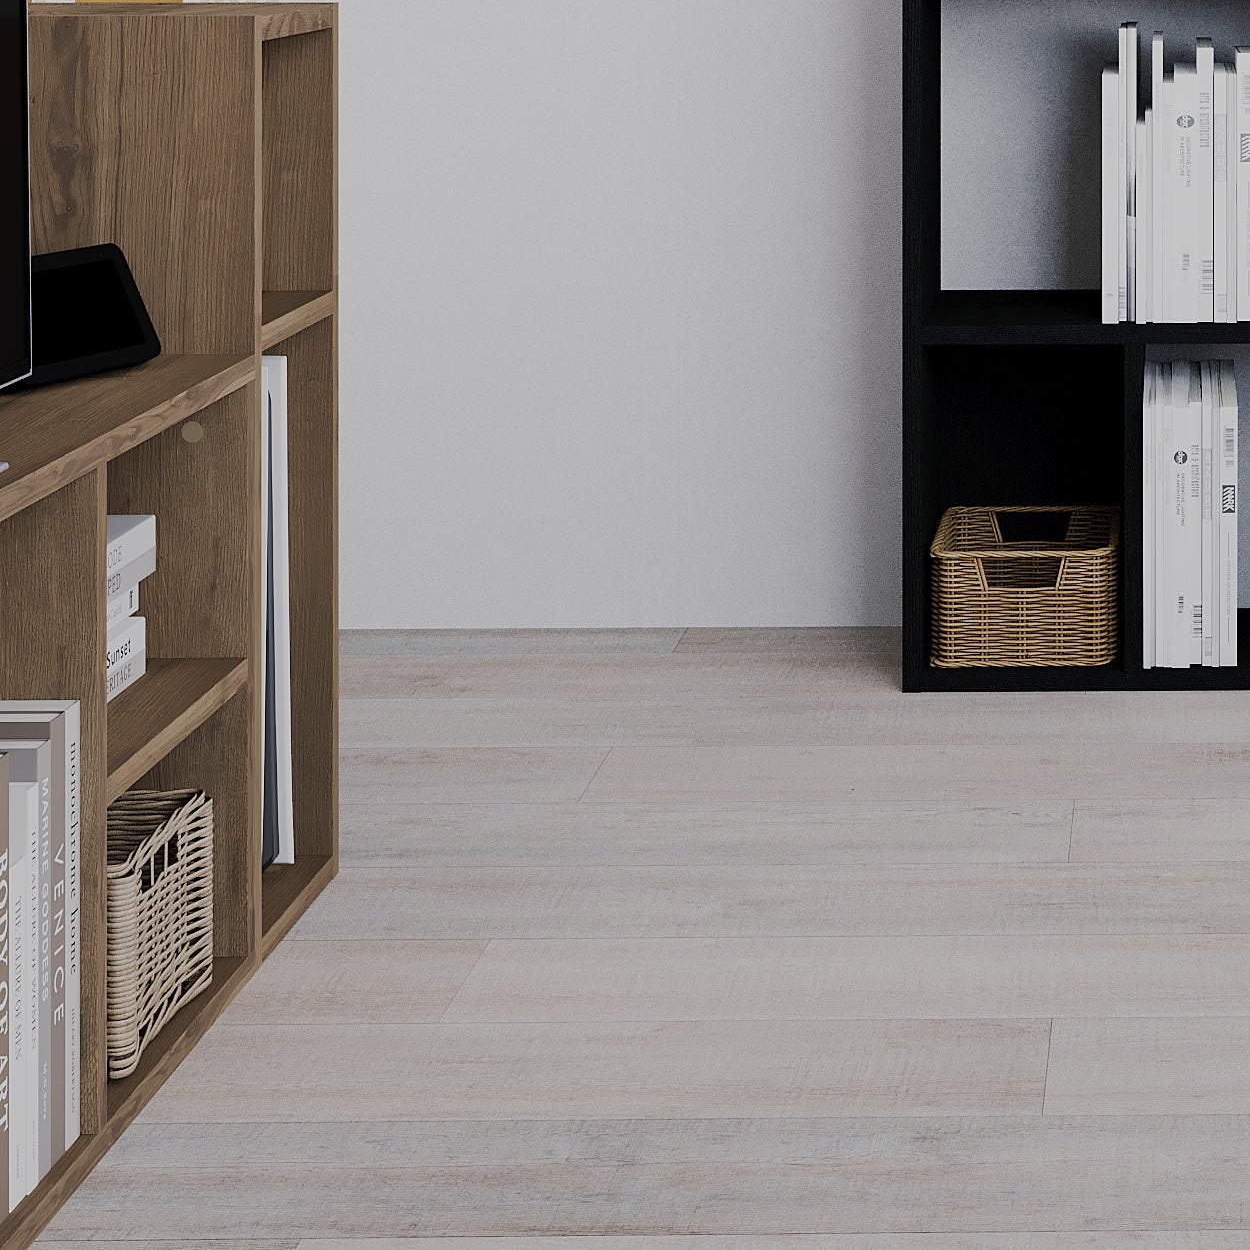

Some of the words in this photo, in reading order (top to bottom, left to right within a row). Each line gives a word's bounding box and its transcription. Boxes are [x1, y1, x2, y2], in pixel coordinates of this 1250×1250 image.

[1223, 486, 1235, 512] MARK
[107, 545, 123, 569] ODE
[106, 638, 131, 669] Sunset
[106, 663, 132, 694] ERITAGE
[41, 777, 49, 875] MARINE
[70, 742, 79, 898] monochrome
[0, 846, 8, 966] BODY
[41, 882, 49, 1002] GODDESS
[54, 843, 65, 1026] VENICE
[70, 907, 79, 975] home
[0, 980, 8, 1036] OF
[0, 1054, 8, 1134] ART
